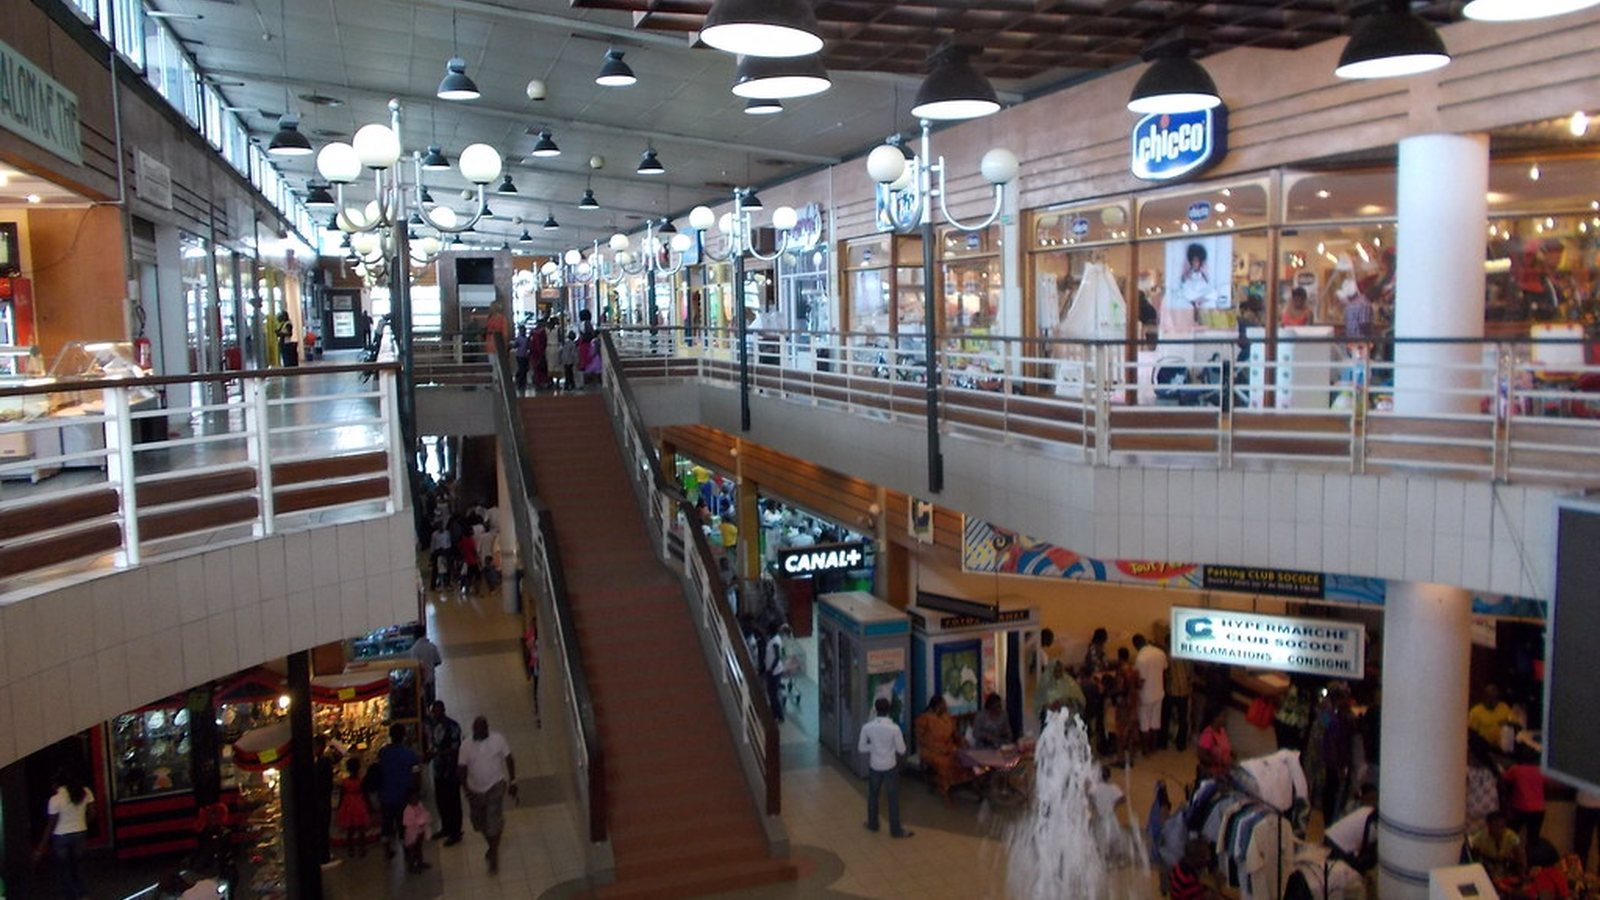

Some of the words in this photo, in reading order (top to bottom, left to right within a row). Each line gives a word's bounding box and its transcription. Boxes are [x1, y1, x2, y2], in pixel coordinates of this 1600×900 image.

[1138, 114, 1203, 163] chicco
[784, 549, 861, 573] CANAL+
[1206, 567, 1246, 580] Parking
[1248, 570, 1275, 581] CLUB
[1279, 572, 1319, 585] SOCOCE
[1221, 619, 1349, 640] HYPERMARCHE
[1226, 633, 1269, 645] CLUB
[1275, 638, 1344, 653] SOCOCE
[1180, 643, 1272, 662] RECLAMATIONS
[1287, 654, 1351, 670] CONSIGNE
